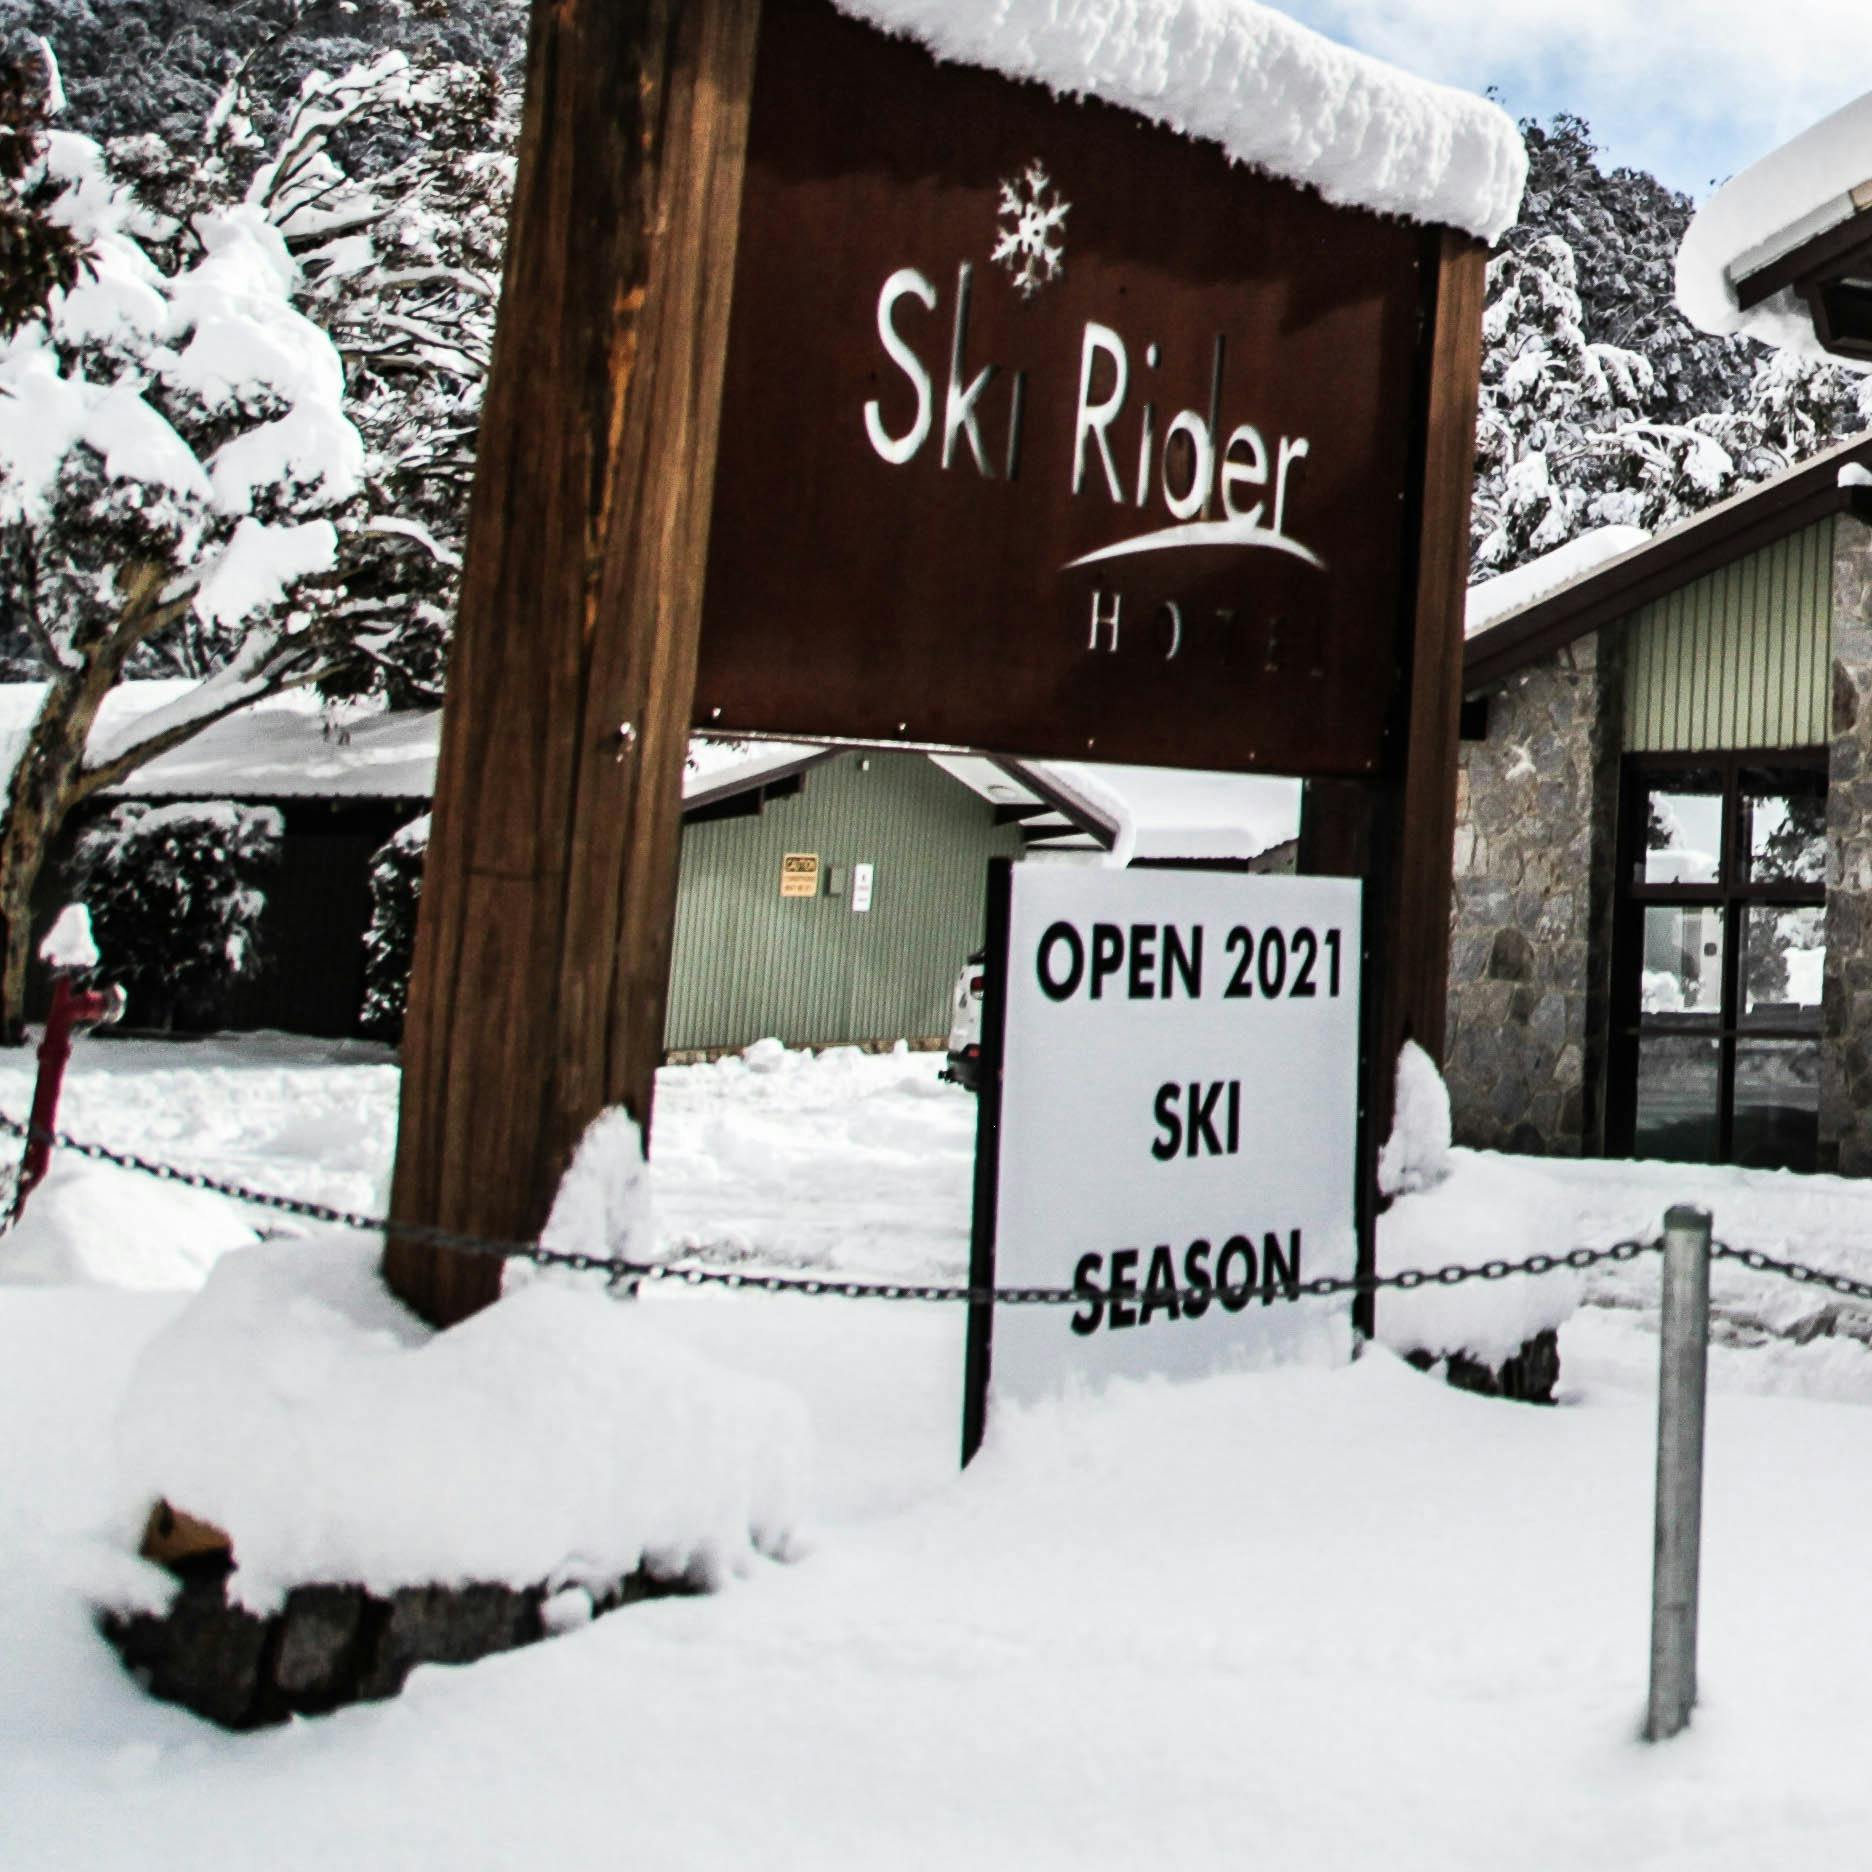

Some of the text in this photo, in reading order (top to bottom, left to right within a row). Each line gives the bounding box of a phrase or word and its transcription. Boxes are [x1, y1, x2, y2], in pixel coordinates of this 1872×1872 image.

[863, 256, 1309, 535] Ski Rider
[1036, 921, 1342, 1002] OPEN 2021
[1152, 1080, 1241, 1161] SKI
[1070, 1229, 1302, 1336] SEASON
